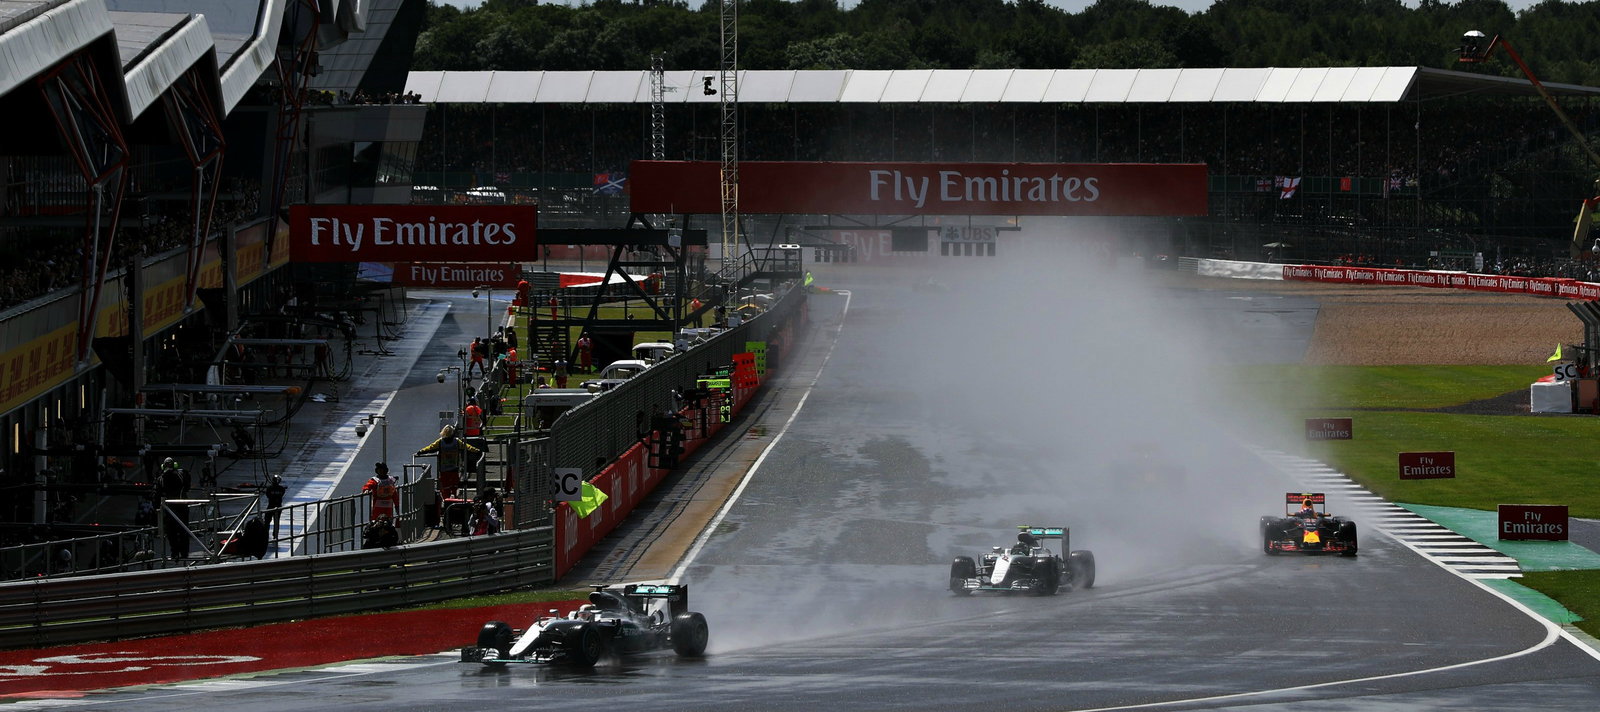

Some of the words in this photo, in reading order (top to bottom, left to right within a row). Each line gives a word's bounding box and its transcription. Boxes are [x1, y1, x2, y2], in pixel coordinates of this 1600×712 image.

[869, 170, 929, 209] Fly
[939, 169, 1100, 203] Emirates
[310, 217, 364, 252] Fly
[373, 216, 516, 246] Emirates
[962, 226, 992, 242] UBS
[412, 266, 437, 285] Fly
[441, 266, 504, 283] Emirates
[1555, 364, 1576, 380] SC
[1309, 429, 1349, 438] Emirates
[1420, 457, 1434, 466] Fly
[1403, 465, 1452, 475] Emirates
[1524, 511, 1542, 522] Fly
[1503, 521, 1563, 534] Emirates
